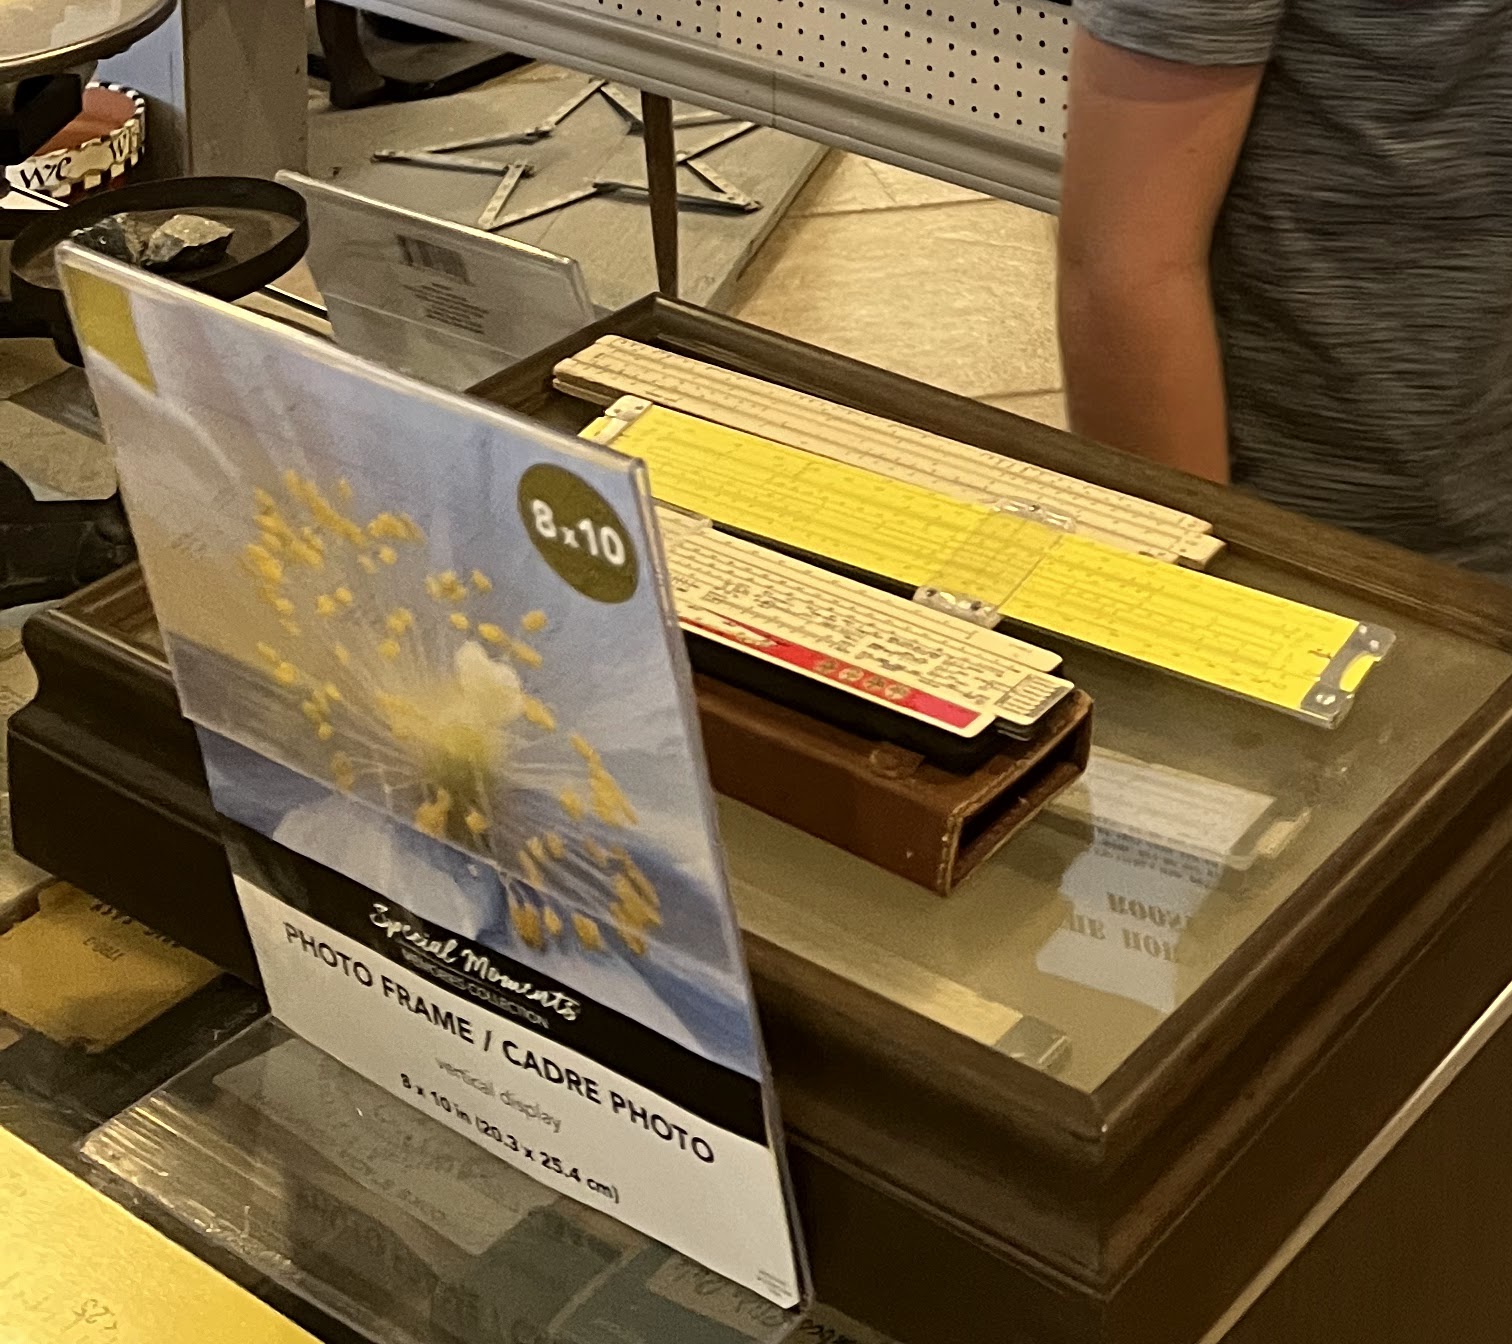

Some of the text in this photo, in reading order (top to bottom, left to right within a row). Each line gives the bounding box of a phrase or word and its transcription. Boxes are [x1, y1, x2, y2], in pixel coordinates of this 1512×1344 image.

[369, 903, 582, 1022] Special Moments
[283, 921, 715, 1165] PHOTO FRAME / CADRE PHOTO
[435, 1057, 562, 1134] vertical display
[400, 1073, 412, 1089] 8
[416, 1085, 426, 1097] x
[430, 1091, 452, 1113] 10
[454, 1103, 473, 1125] in
[523, 1146, 535, 1162] x
[539, 1151, 581, 1183] 25.4
[586, 1178, 620, 1205] cm)
